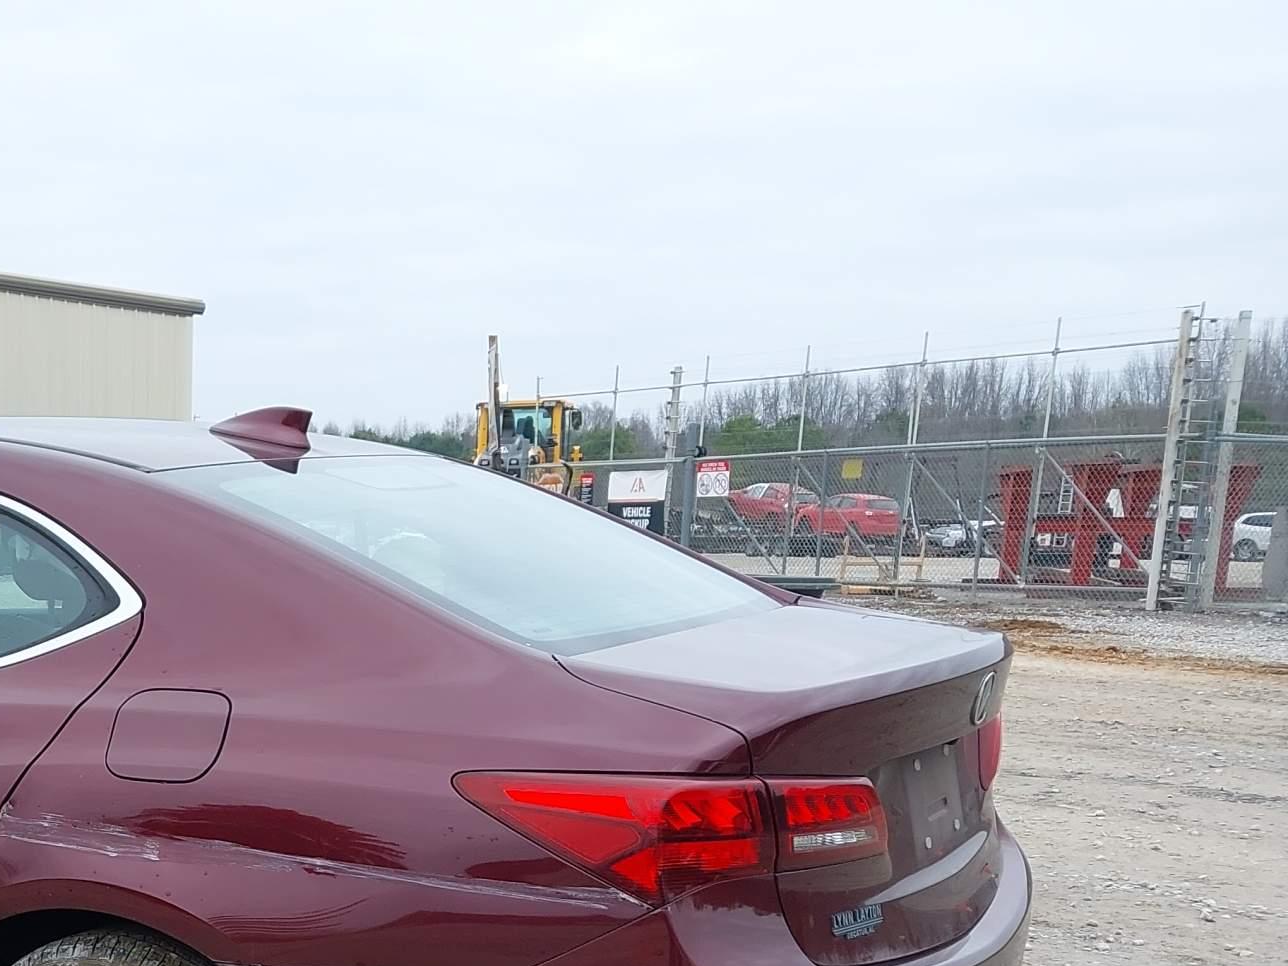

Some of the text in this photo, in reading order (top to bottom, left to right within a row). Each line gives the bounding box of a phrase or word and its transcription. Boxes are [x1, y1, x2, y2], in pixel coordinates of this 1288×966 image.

[622, 506, 652, 518] VEHICLE
[832, 903, 882, 929] LYNN LAYTON
